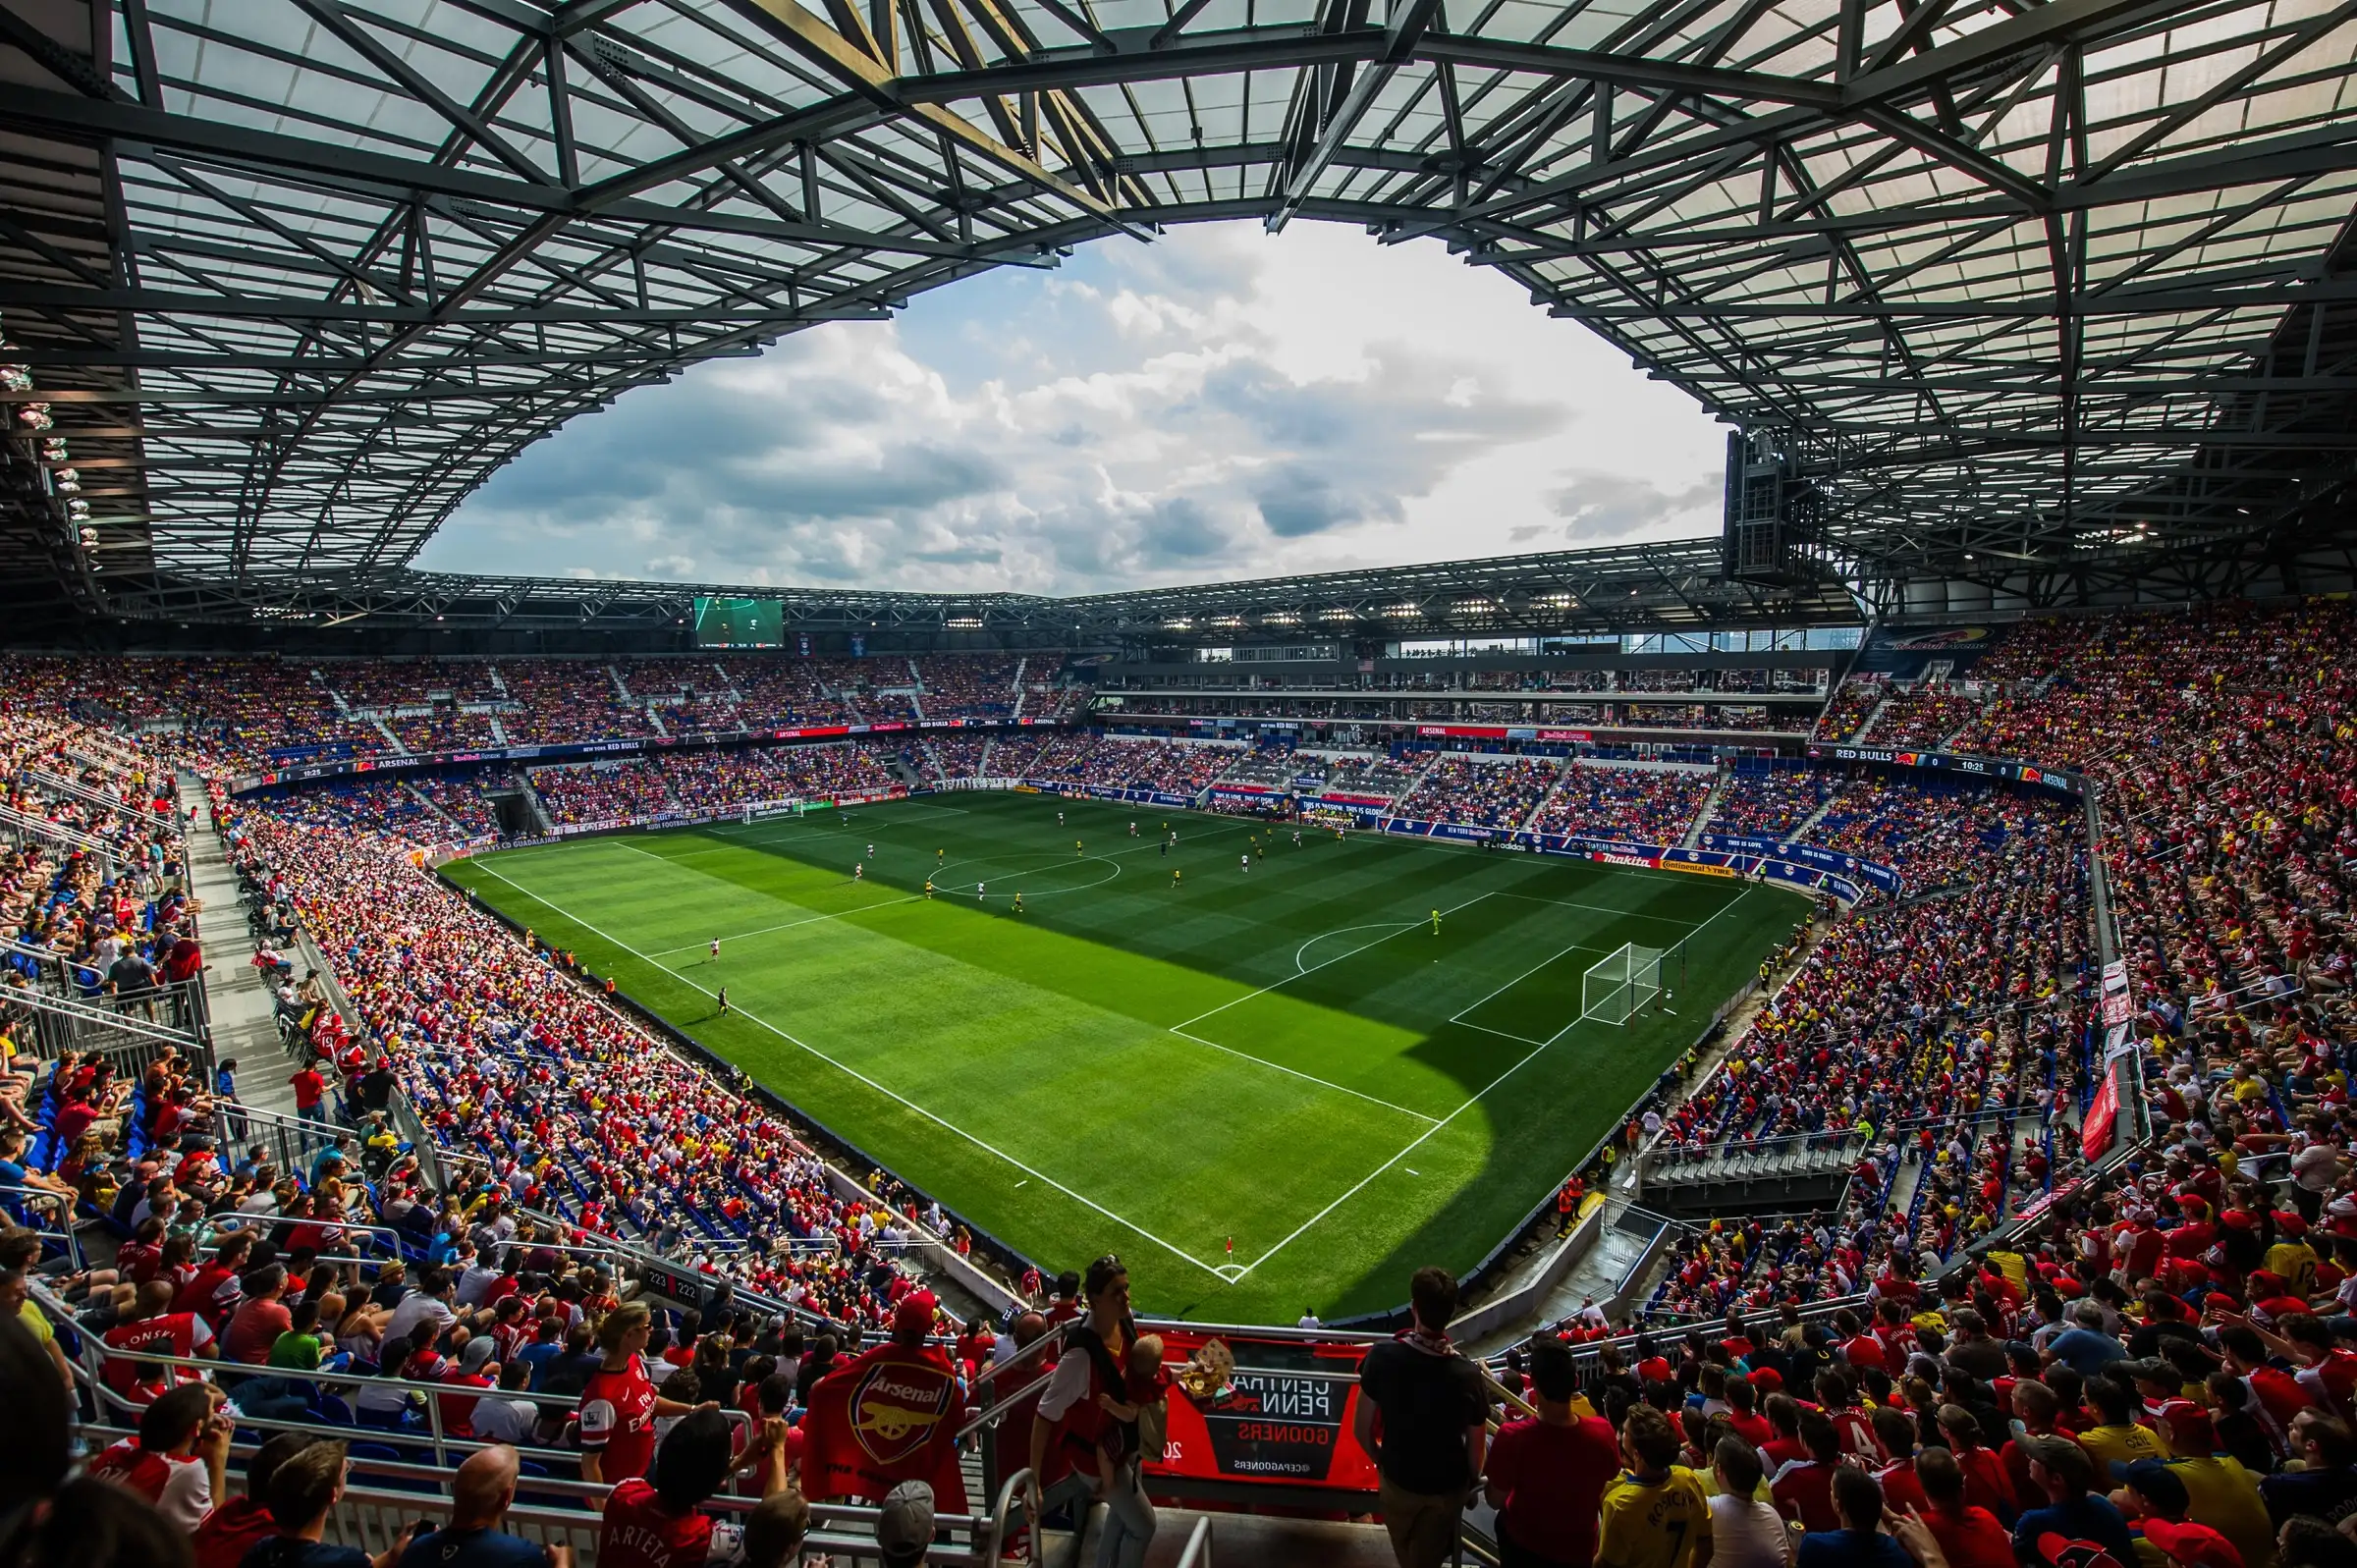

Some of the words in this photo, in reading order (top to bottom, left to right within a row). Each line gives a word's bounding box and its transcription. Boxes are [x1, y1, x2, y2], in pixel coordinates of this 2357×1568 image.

[1836, 749, 1856, 759] RED
[1859, 750, 1892, 761] BULLS
[378, 758, 419, 769] ARSENAL
[1962, 761, 1984, 772] 10:25
[2043, 774, 2067, 789] ARSENAL
[662, 819, 688, 829] FOOTBALL
[690, 816, 712, 825] SUMMIT
[491, 842, 500, 851] VS
[514, 836, 561, 848] GUADALAJARA
[1500, 841, 1526, 851] adidas
[1663, 860, 1705, 873] Continental
[119, 1247, 148, 1258] RAMSEY
[649, 1271, 666, 1287] 223
[678, 1282, 695, 1299] 222
[869, 1377, 943, 1403] Arsenal
[638, 1390, 652, 1407] Fly
[1850, 1421, 1881, 1463] 4
[609, 1525, 672, 1568] ARTETA
[1666, 1520, 1687, 1568] 7
